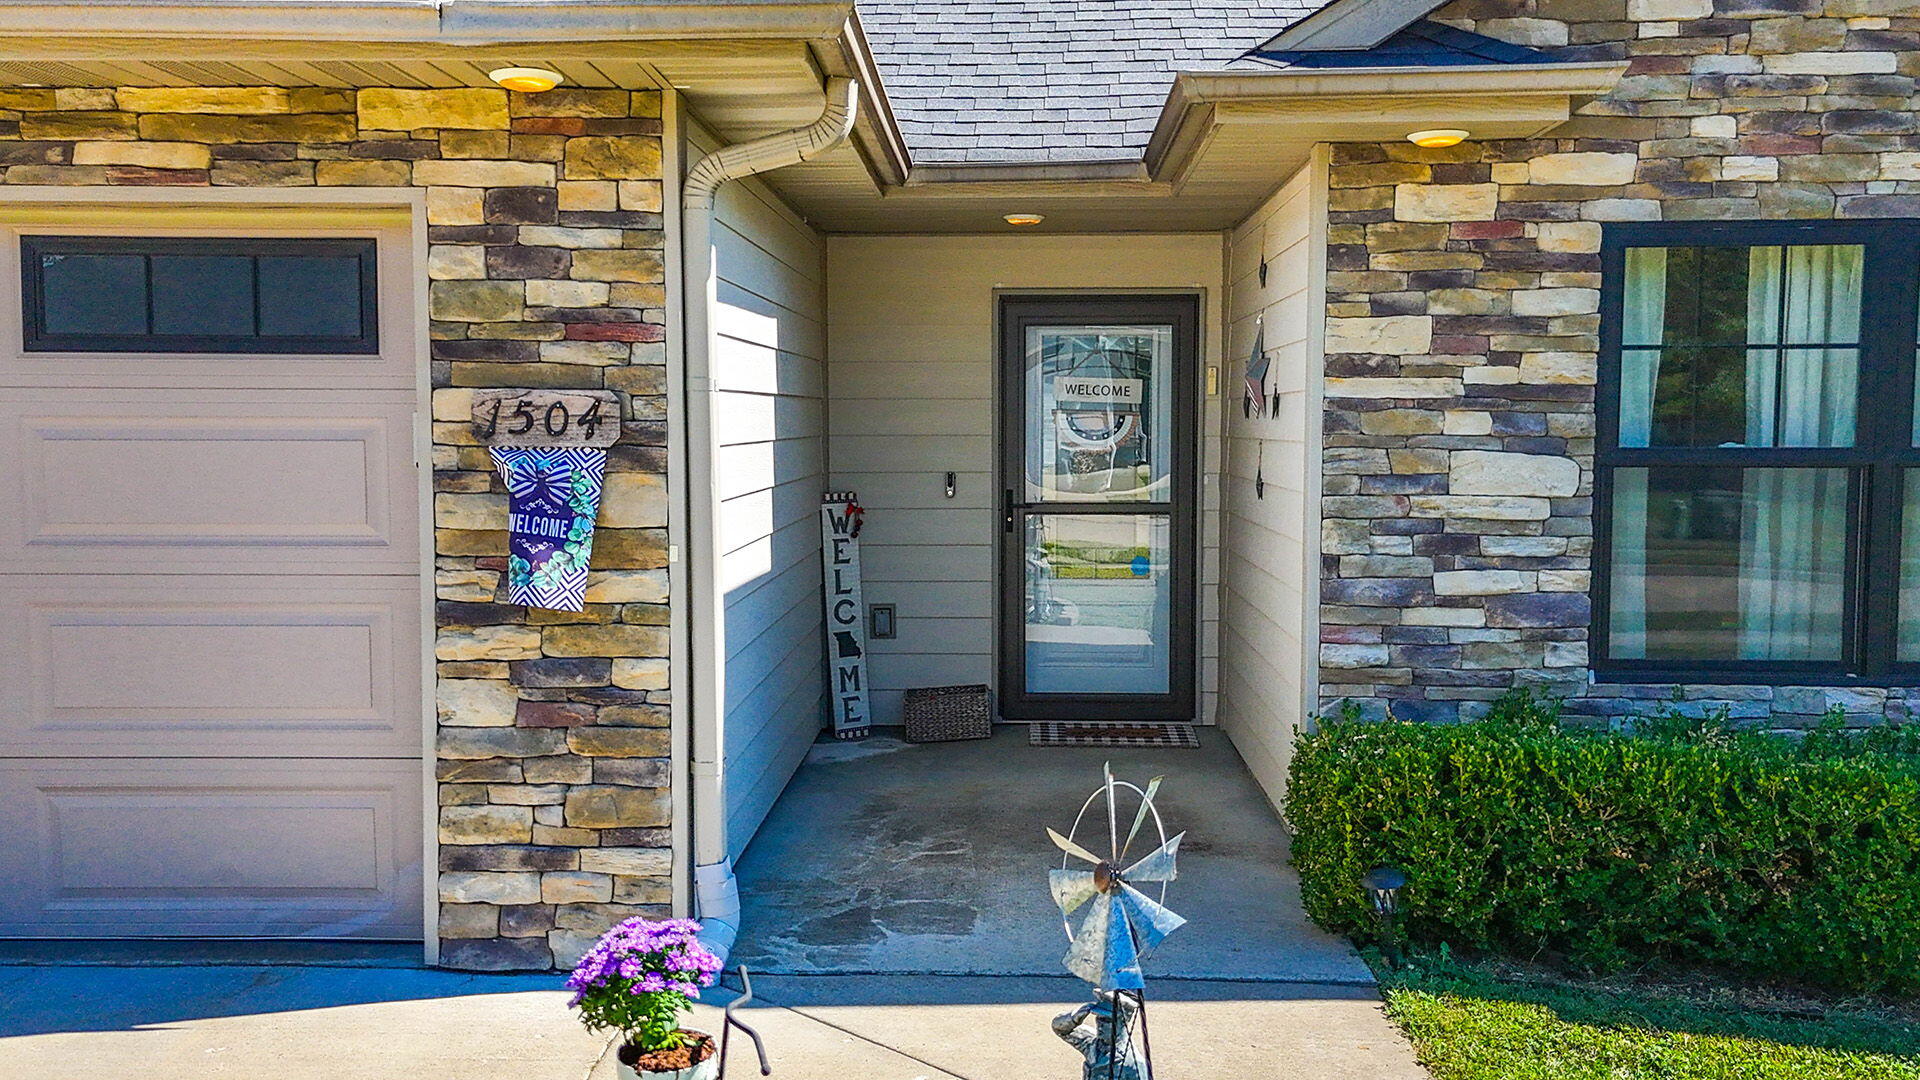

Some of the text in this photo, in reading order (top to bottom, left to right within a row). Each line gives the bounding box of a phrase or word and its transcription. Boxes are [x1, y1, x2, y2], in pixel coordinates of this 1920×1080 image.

[1064, 383, 1131, 397] WELCOME
[478, 398, 603, 441] 1504
[827, 508, 864, 723] WELCME
